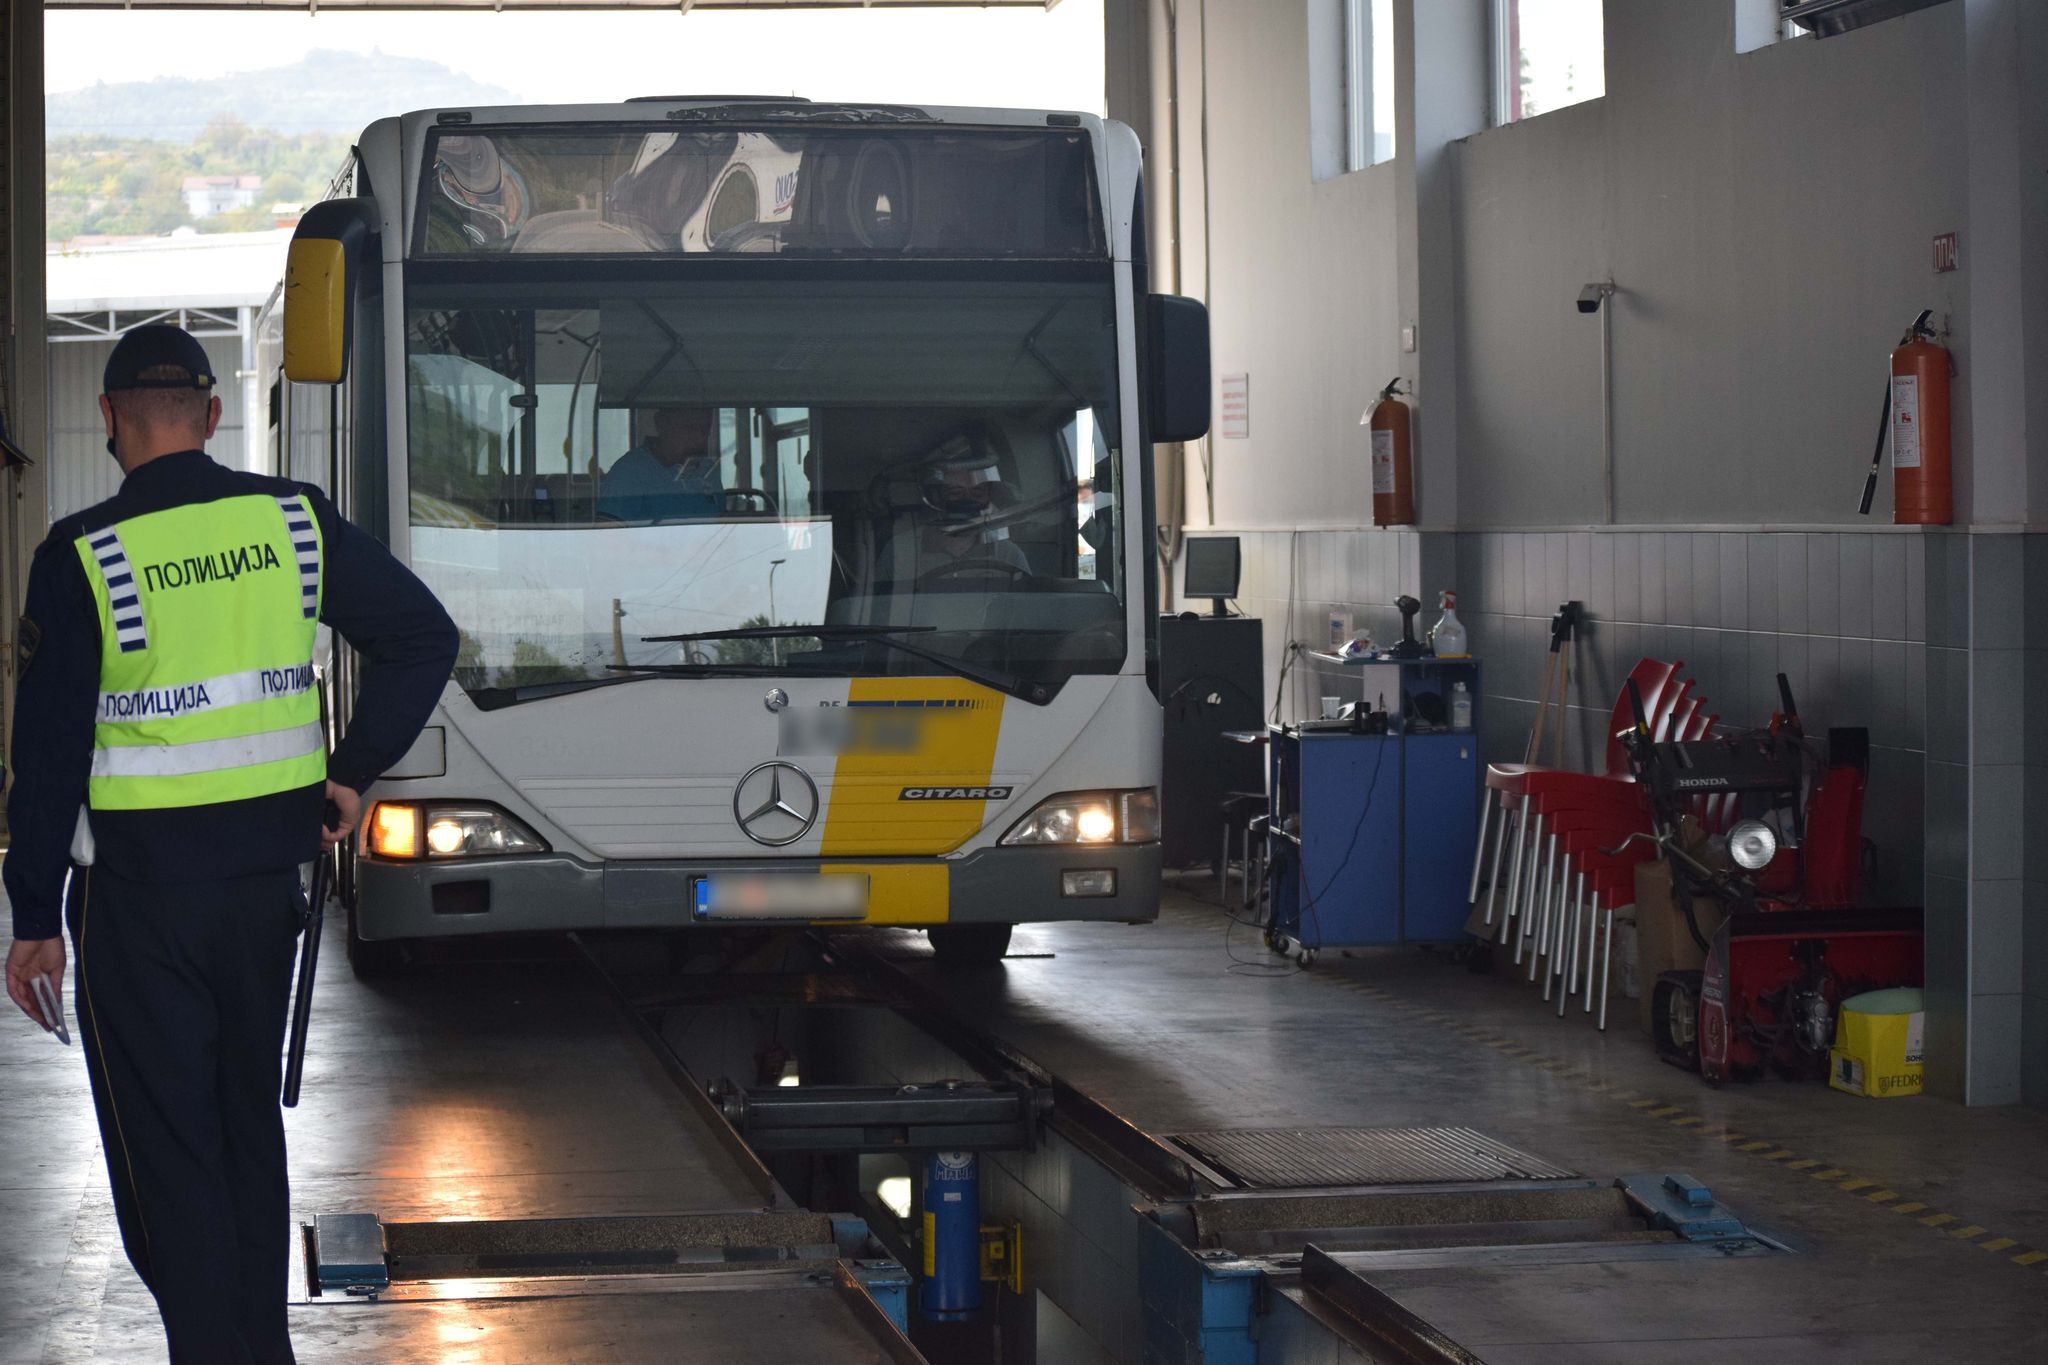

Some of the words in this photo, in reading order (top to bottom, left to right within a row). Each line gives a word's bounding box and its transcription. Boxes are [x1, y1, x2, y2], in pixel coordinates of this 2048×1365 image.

[143, 543, 281, 592] ПОЛИЦИЈА
[105, 683, 211, 717] ПОЛИЦИЈА
[1680, 777, 1728, 787] HONDA
[904, 788, 1007, 799] CITARO
